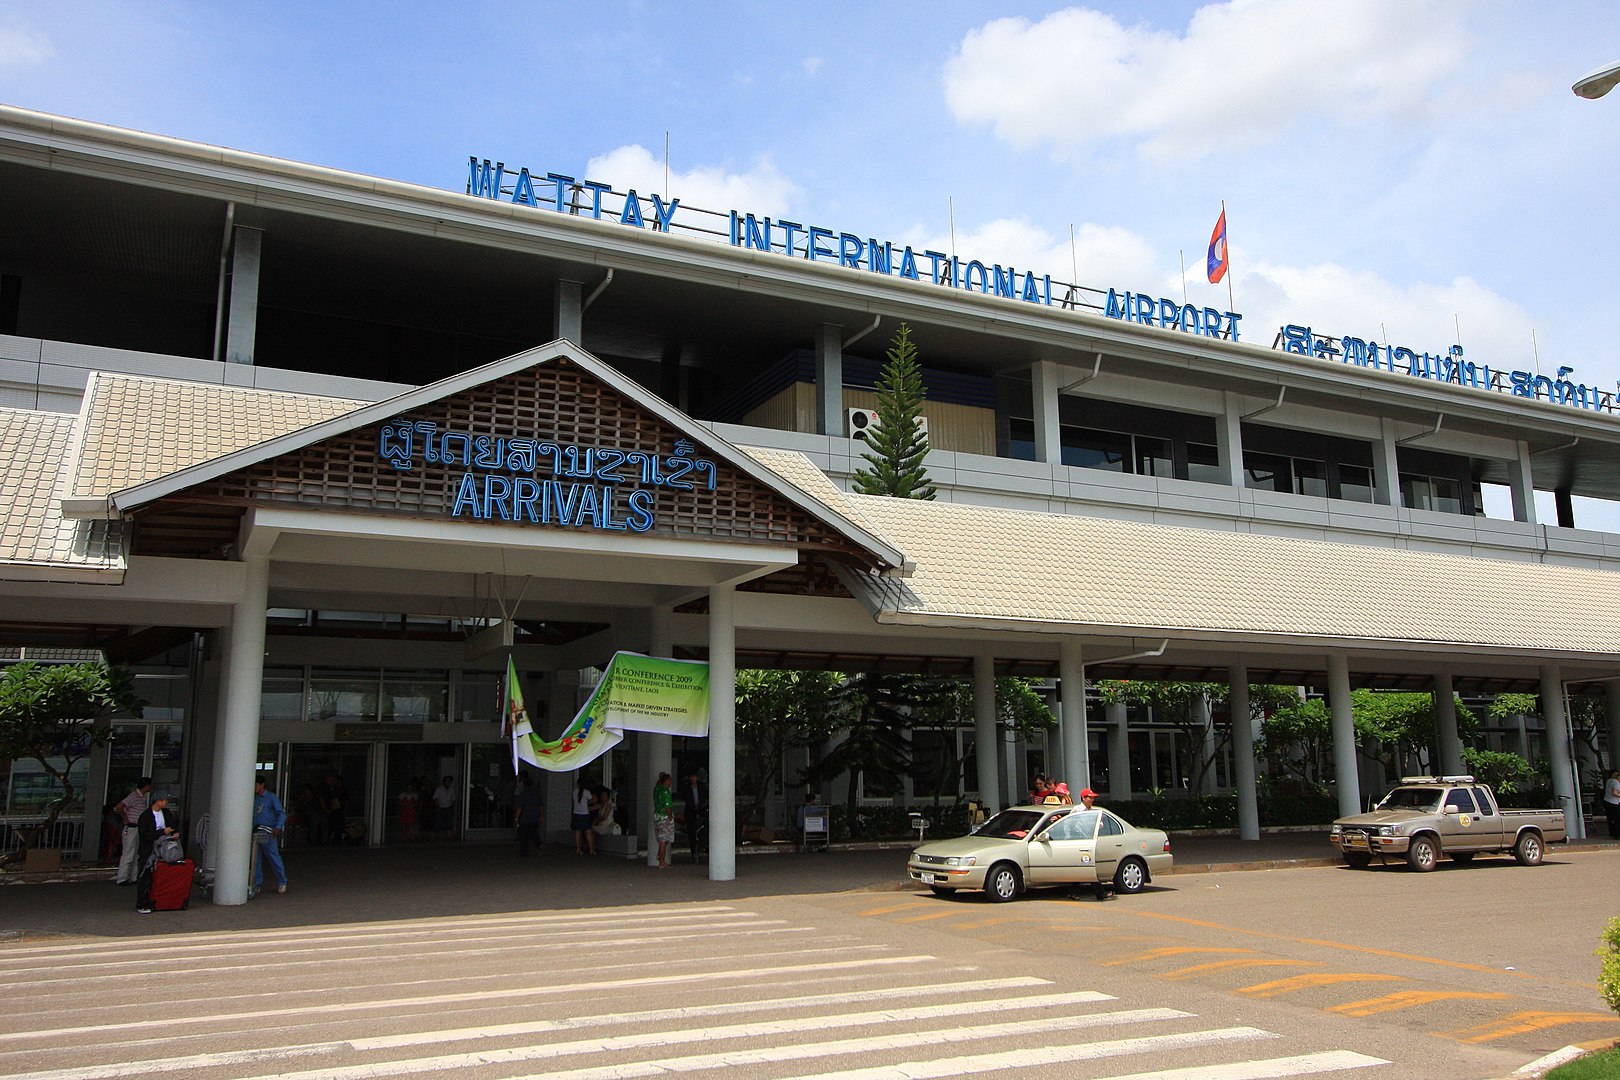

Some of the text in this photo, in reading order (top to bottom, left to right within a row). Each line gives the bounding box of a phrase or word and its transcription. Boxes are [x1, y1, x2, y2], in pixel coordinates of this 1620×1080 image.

[469, 156, 680, 233] WATTAY
[1104, 288, 1242, 342] AIRPORT
[452, 472, 655, 532] ARRIVALS
[622, 668, 674, 682] CONFERENCE
[676, 675, 693, 684] 2009
